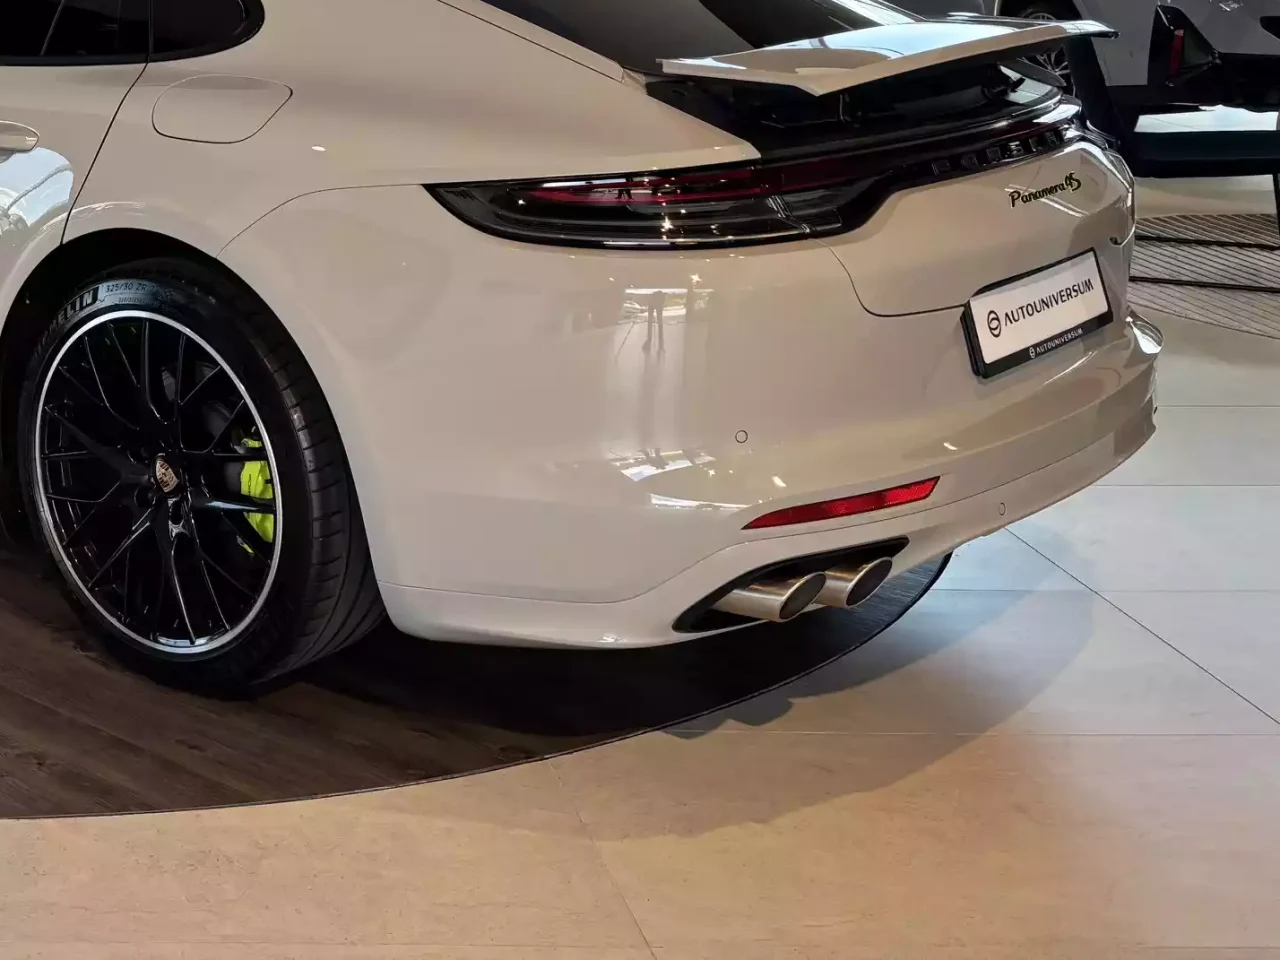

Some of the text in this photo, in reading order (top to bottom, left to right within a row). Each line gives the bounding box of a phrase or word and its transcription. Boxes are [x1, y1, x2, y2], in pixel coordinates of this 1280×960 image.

[1009, 184, 1065, 208] Panamera
[1004, 278, 1095, 327] AUTOUNIVERSUM
[1036, 327, 1083, 354] AUTOUNIVERSUM
